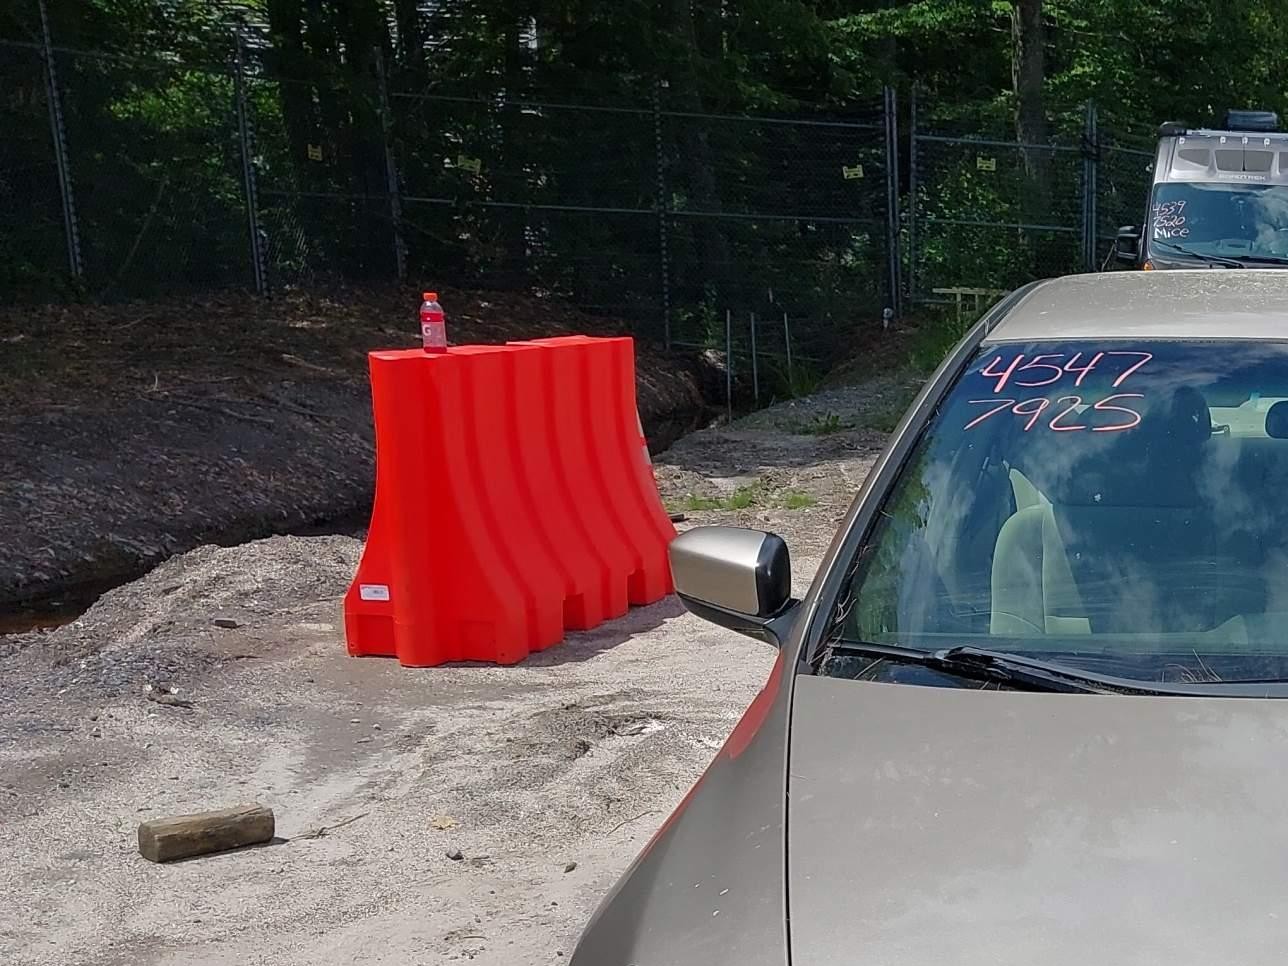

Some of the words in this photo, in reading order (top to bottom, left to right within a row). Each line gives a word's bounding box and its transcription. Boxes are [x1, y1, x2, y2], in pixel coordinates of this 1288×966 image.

[422, 324, 432, 336] G
[981, 350, 1154, 393] 4547
[963, 393, 1145, 432] 7925
